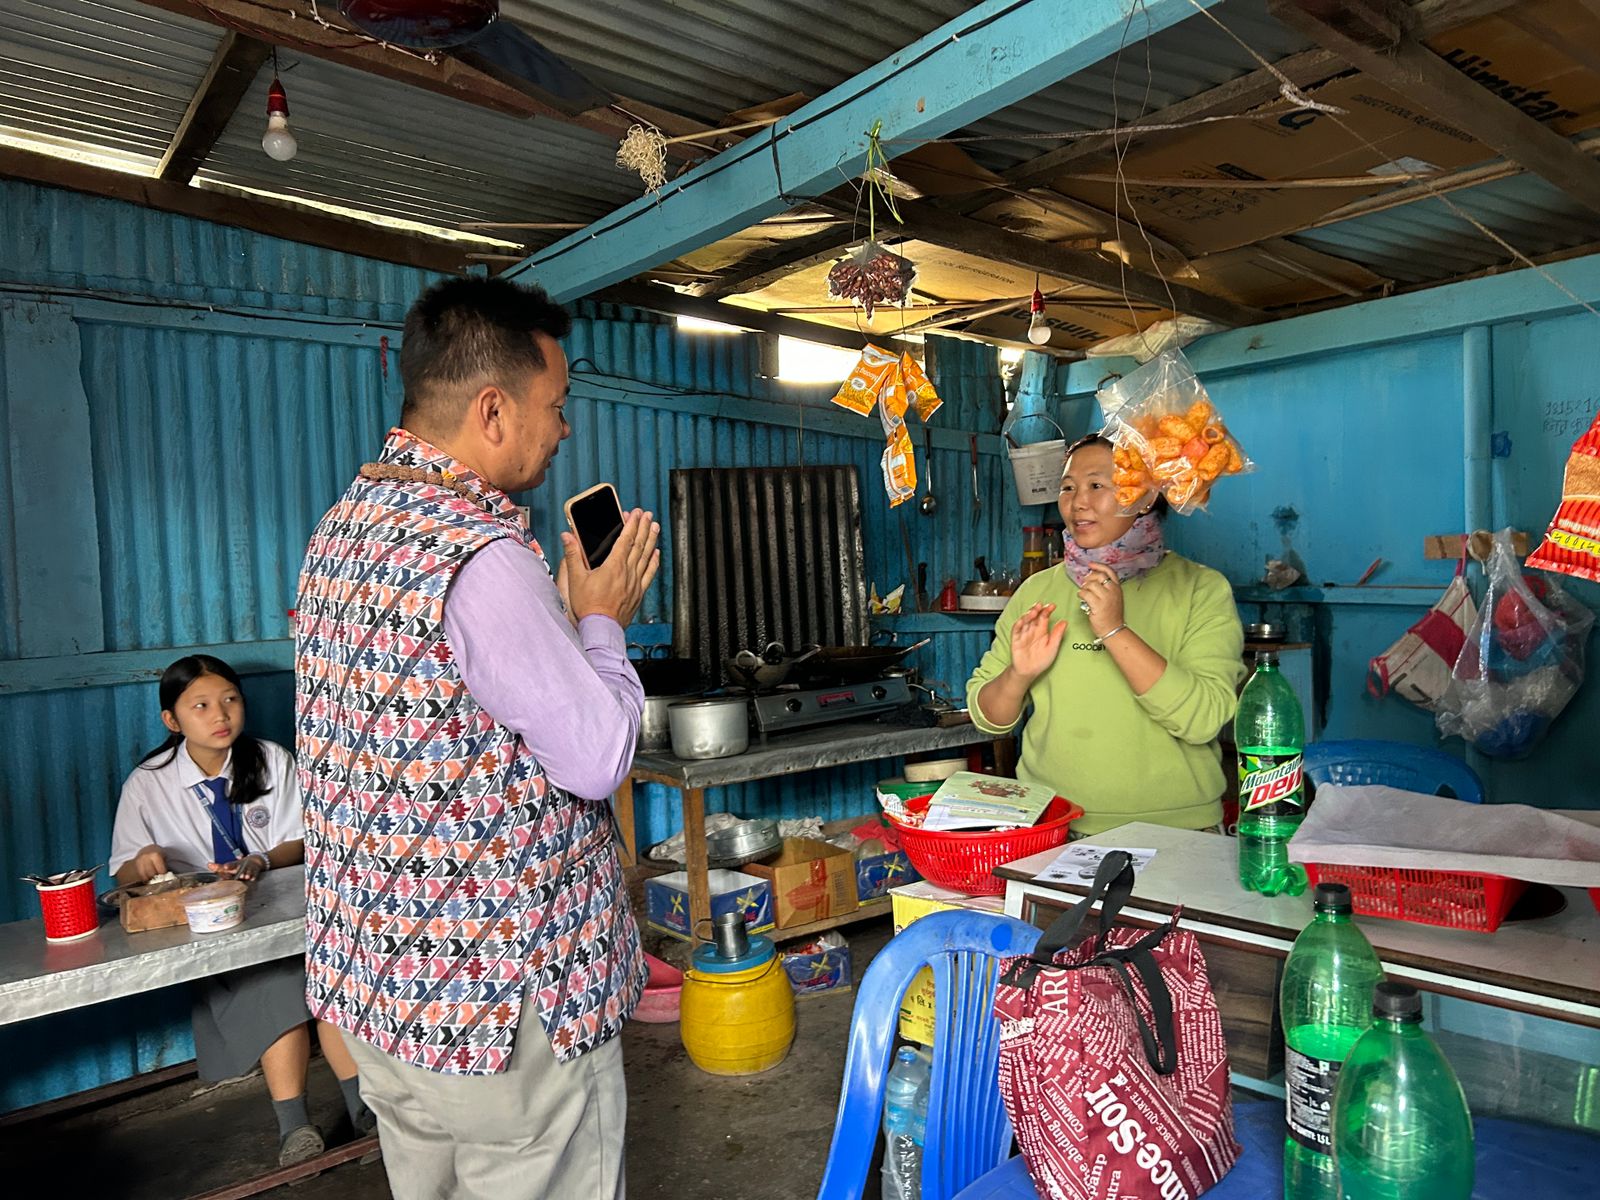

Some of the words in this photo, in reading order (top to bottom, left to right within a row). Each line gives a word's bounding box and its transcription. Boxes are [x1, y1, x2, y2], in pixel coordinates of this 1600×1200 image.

[1241, 757, 1301, 791] Mountain
[1044, 1083, 1085, 1135] COMMENT
[1044, 1118, 1084, 1166] abiding
